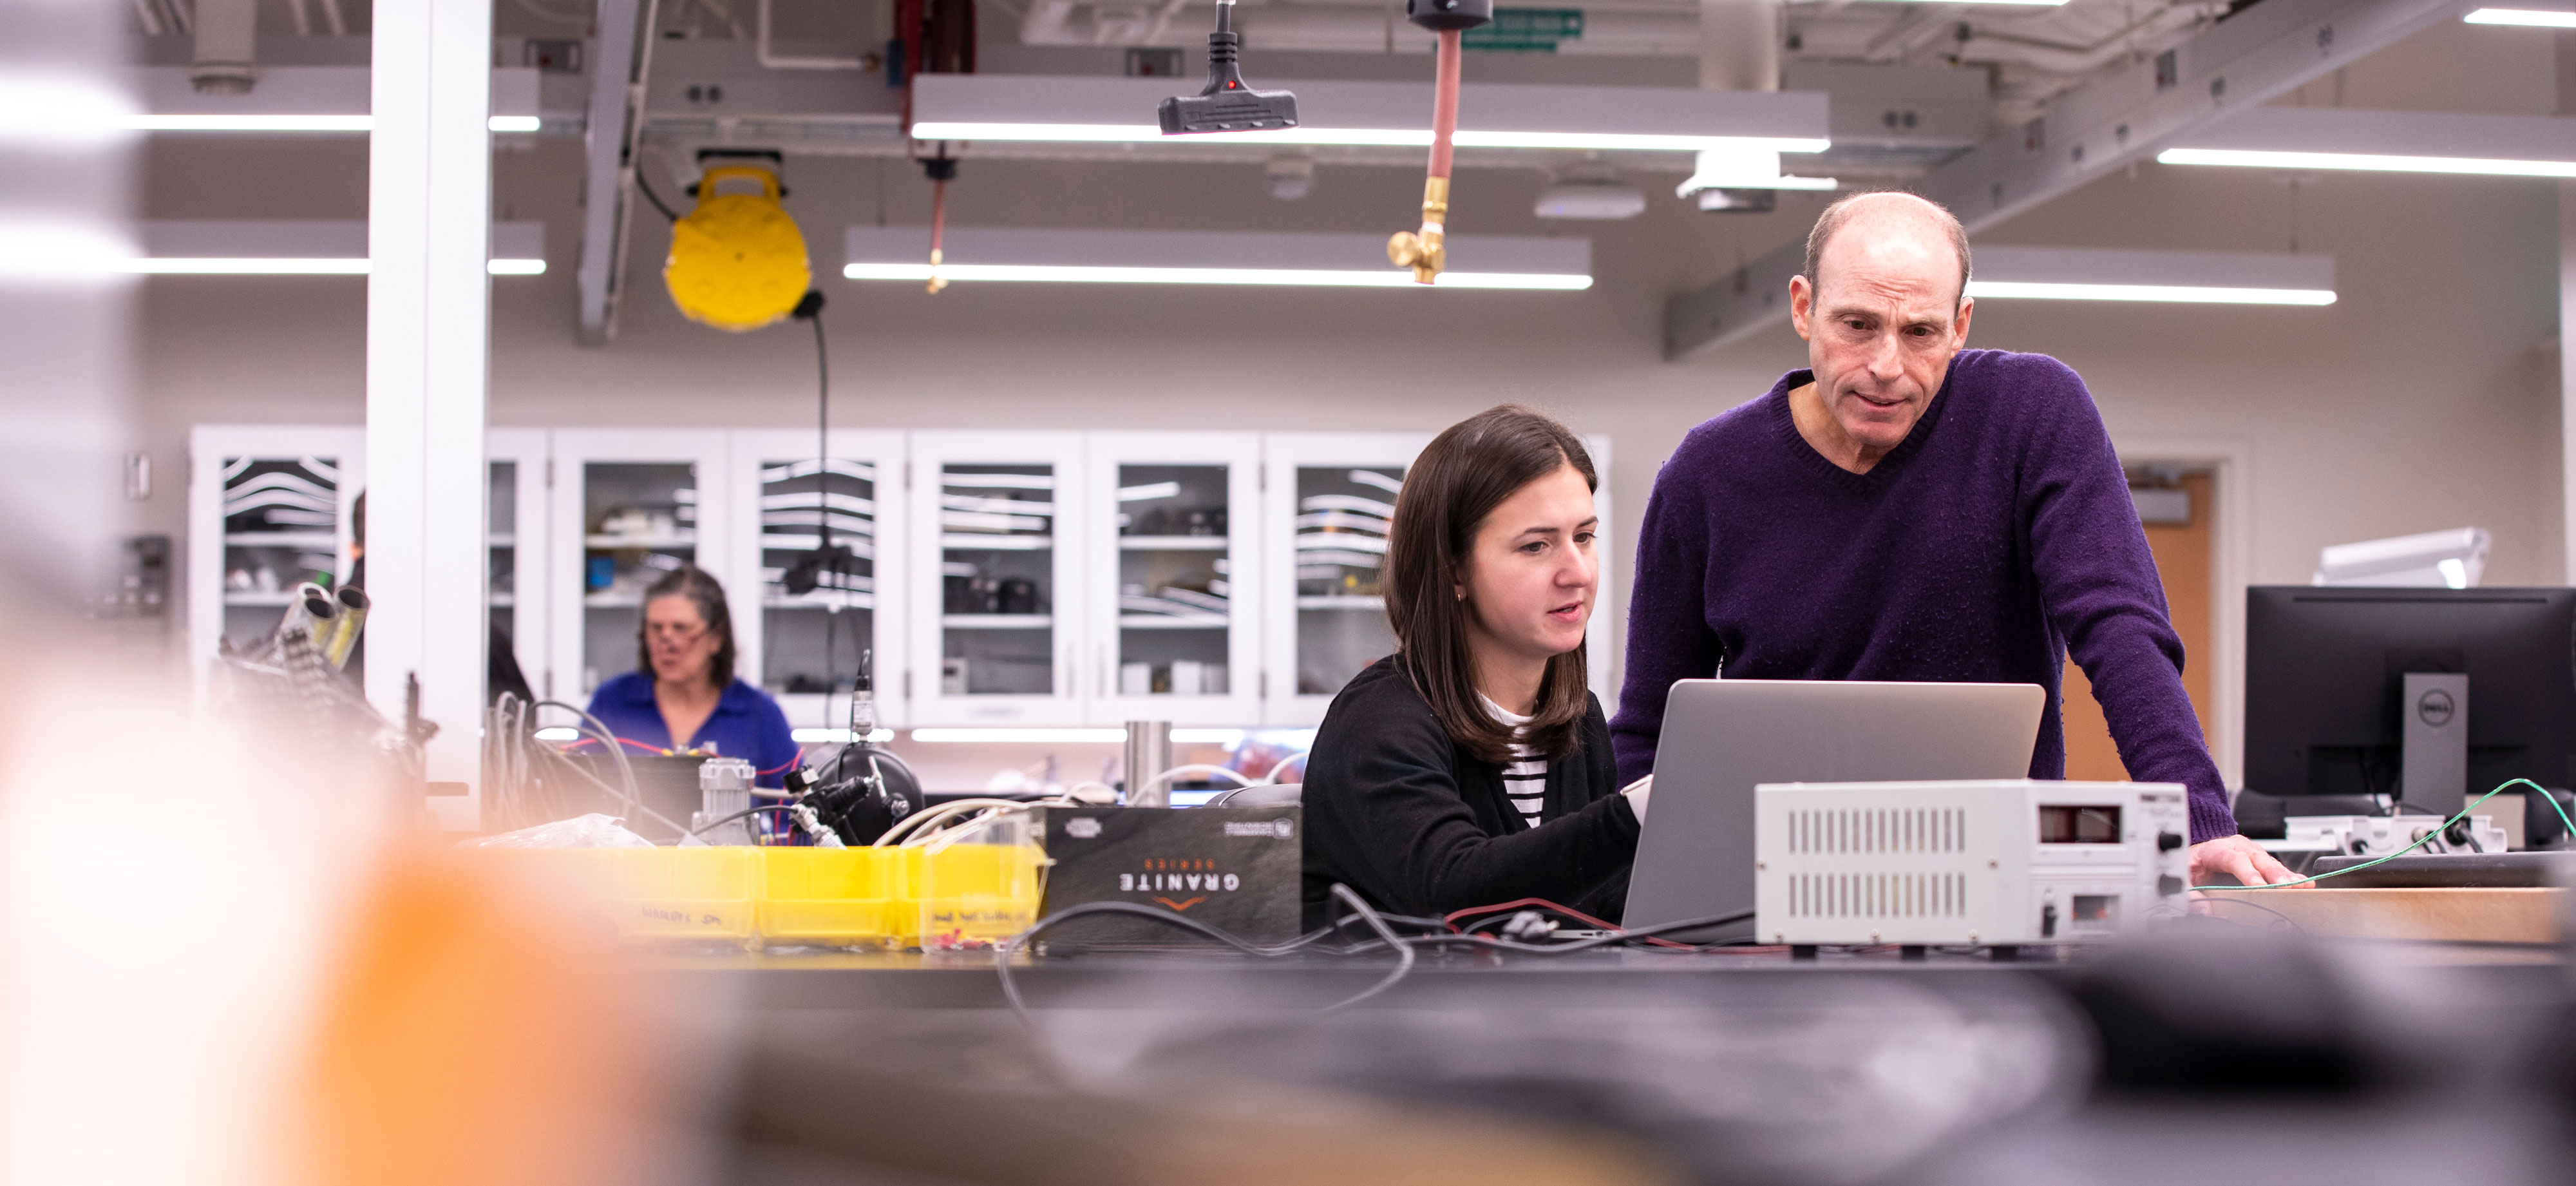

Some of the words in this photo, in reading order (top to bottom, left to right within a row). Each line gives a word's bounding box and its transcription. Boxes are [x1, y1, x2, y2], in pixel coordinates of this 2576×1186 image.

[2423, 704, 2448, 713] DELL
[1144, 857, 1215, 871] SERIES
[1119, 873, 1240, 892] GRANITE
